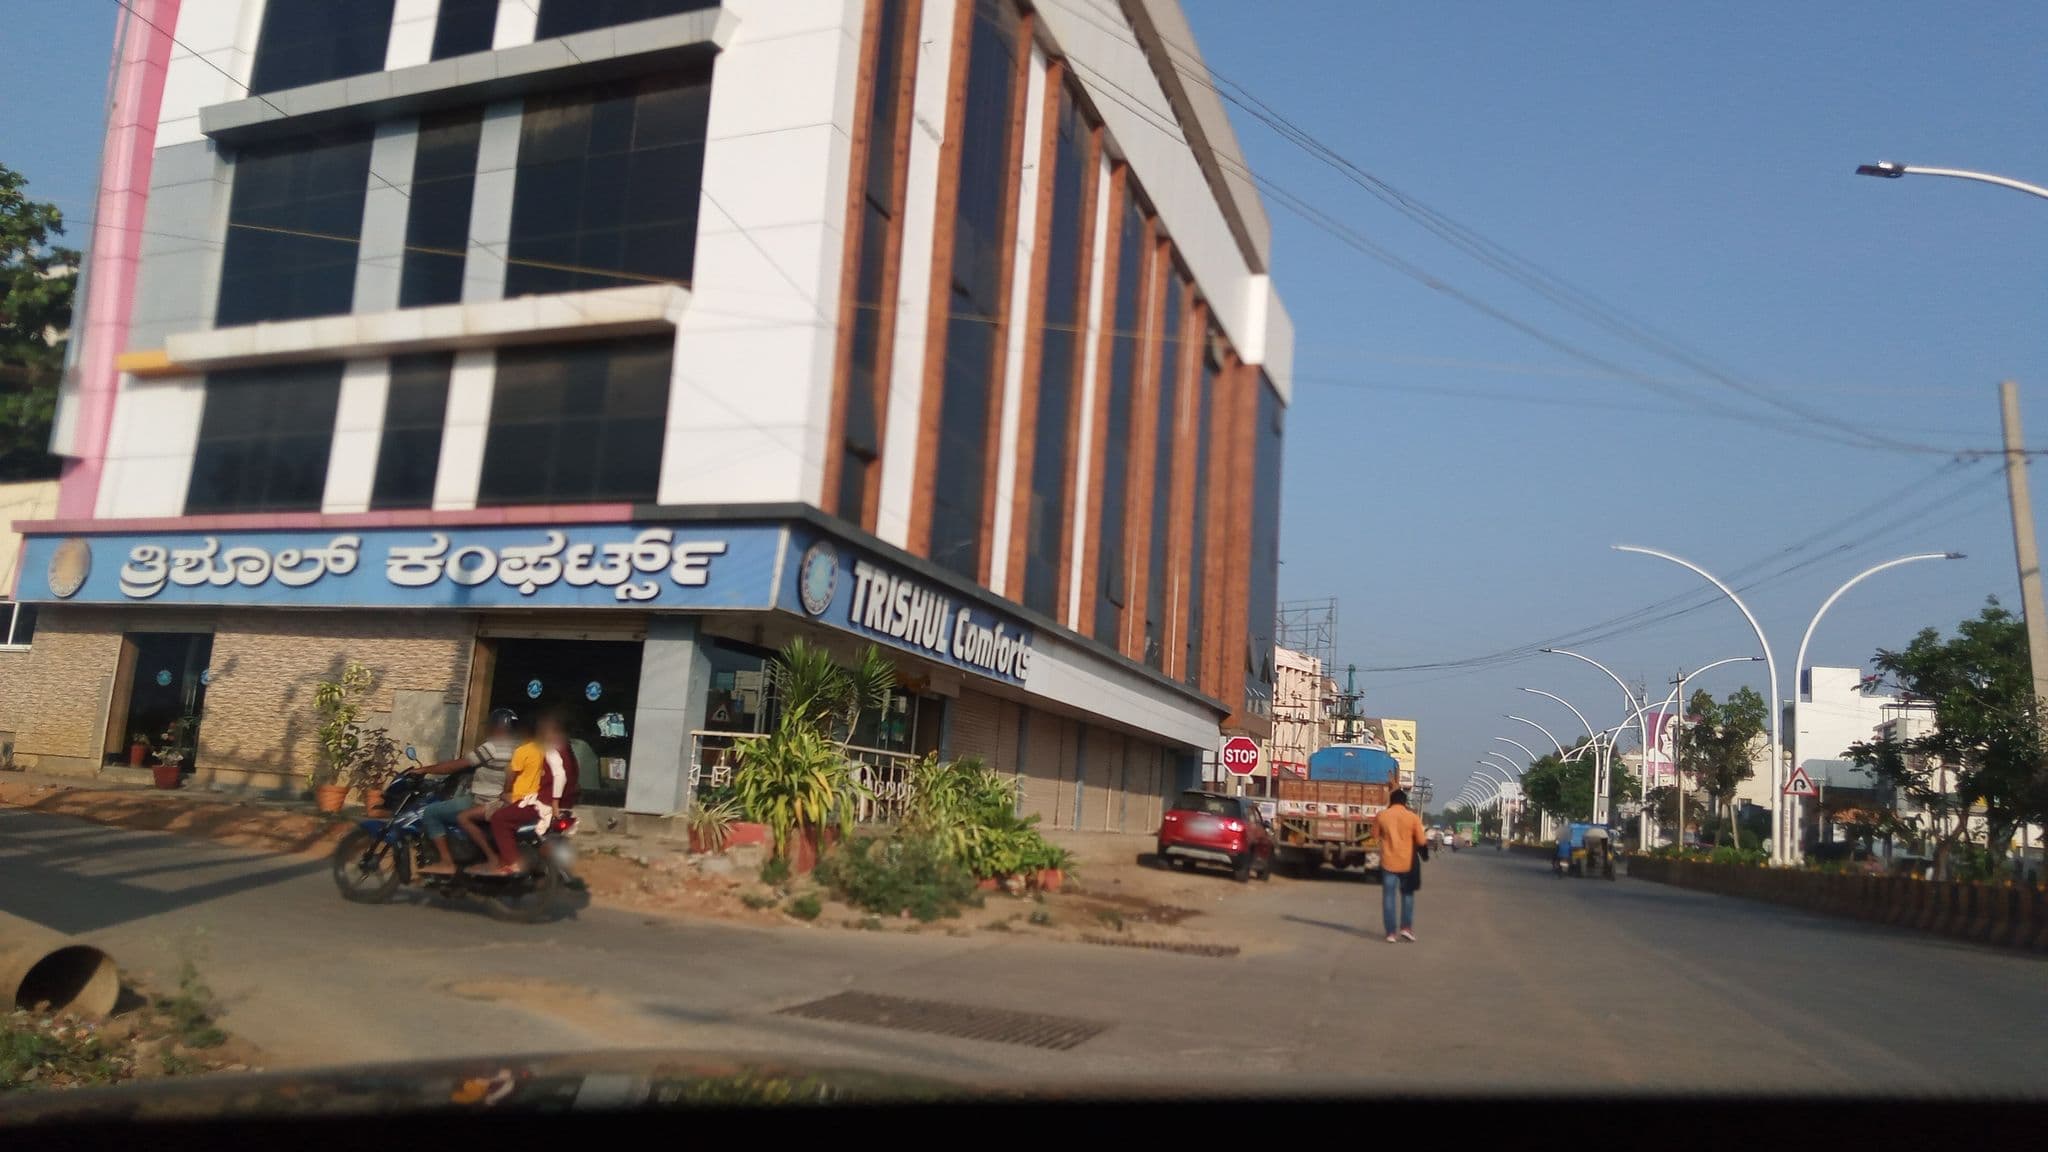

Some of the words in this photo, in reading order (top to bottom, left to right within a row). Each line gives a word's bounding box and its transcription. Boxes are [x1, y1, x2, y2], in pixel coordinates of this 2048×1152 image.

[119, 534, 361, 599] ತ್ರಿಶೂಲ್
[852, 561, 949, 653] TRISHUL
[953, 608, 1033, 678] Comforts
[1225, 748, 1257, 764] STOP
